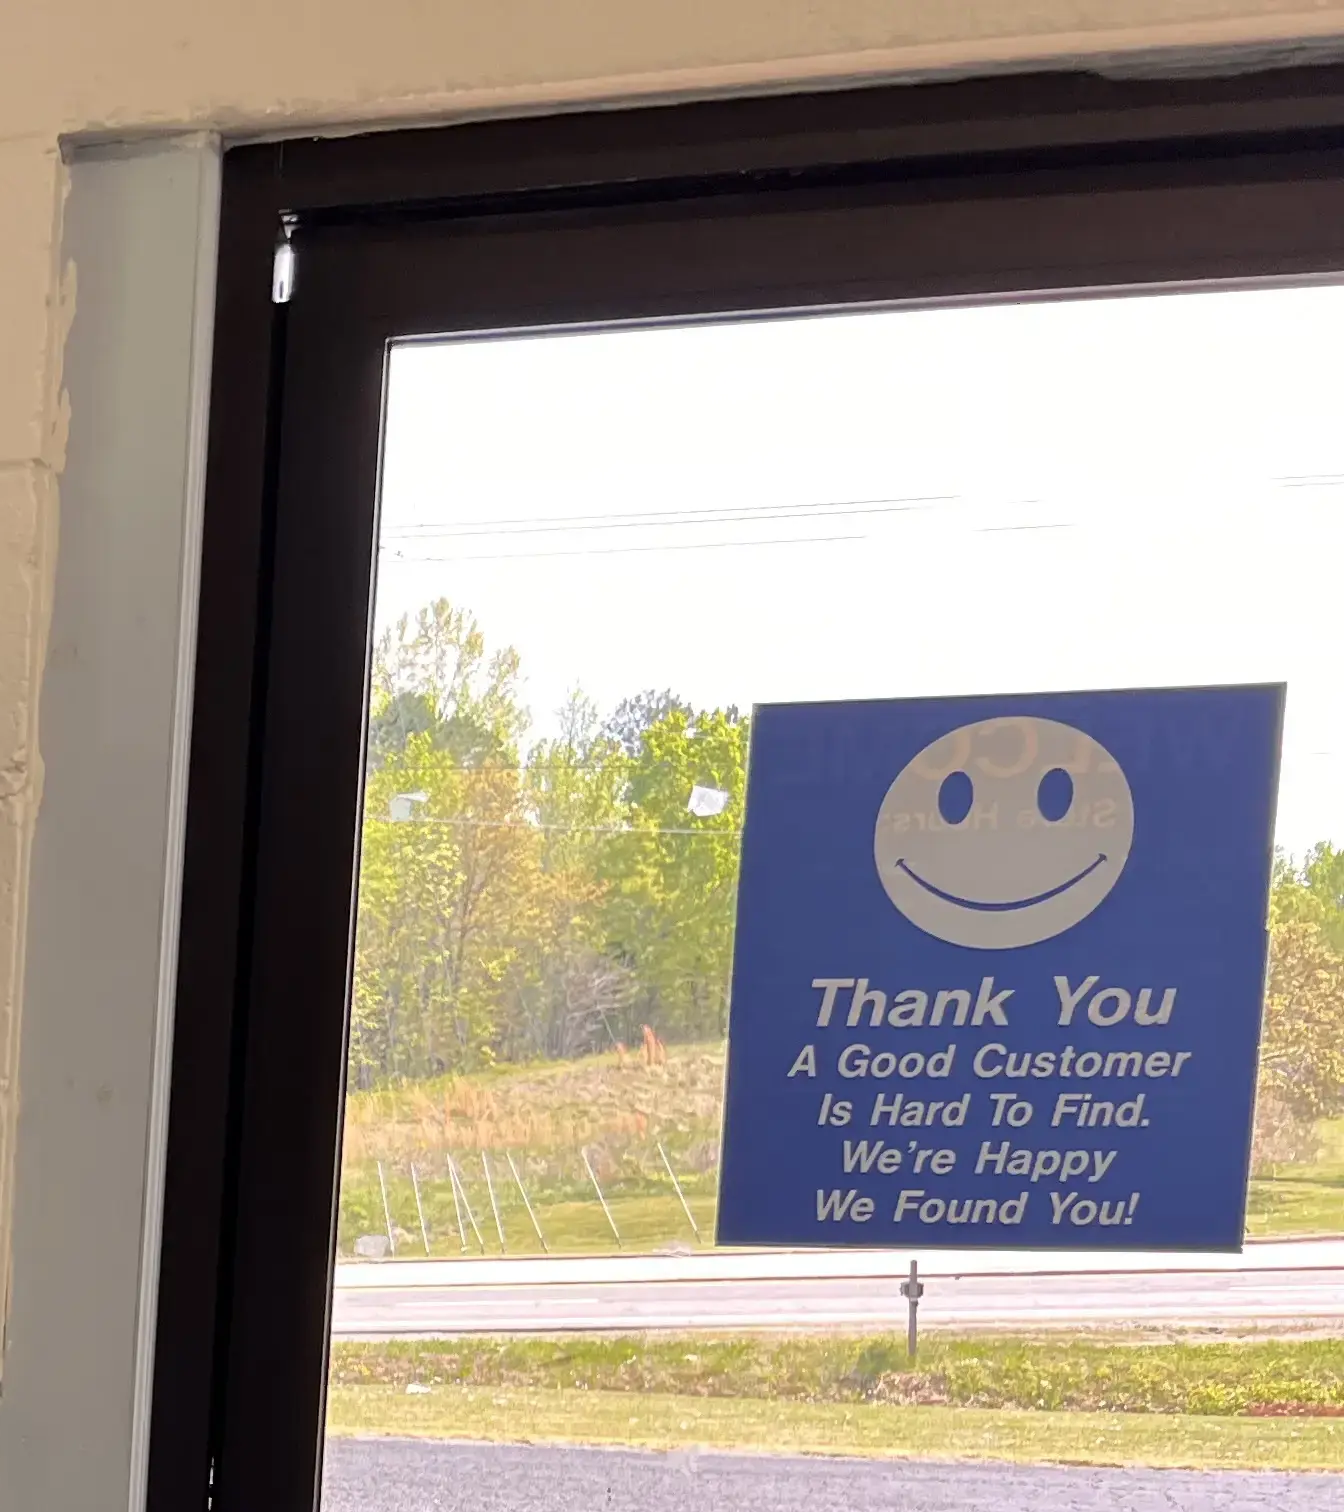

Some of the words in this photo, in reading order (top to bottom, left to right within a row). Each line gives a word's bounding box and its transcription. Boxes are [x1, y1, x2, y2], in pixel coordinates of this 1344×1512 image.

[811, 976, 1015, 1027] Thank
[1053, 975, 1178, 1027] You
[787, 1044, 817, 1078] A
[837, 1044, 957, 1078] Good
[972, 1042, 1193, 1078] Customer
[817, 1093, 853, 1127] Is
[870, 1093, 972, 1127] Hard
[989, 1093, 1033, 1127] To
[1050, 1093, 1150, 1127] Find.
[842, 1140, 957, 1174] We're
[974, 1141, 1117, 1183] Happy
[815, 1189, 875, 1222] We
[894, 1190, 1029, 1224] Found
[1050, 1191, 1141, 1225] You!
